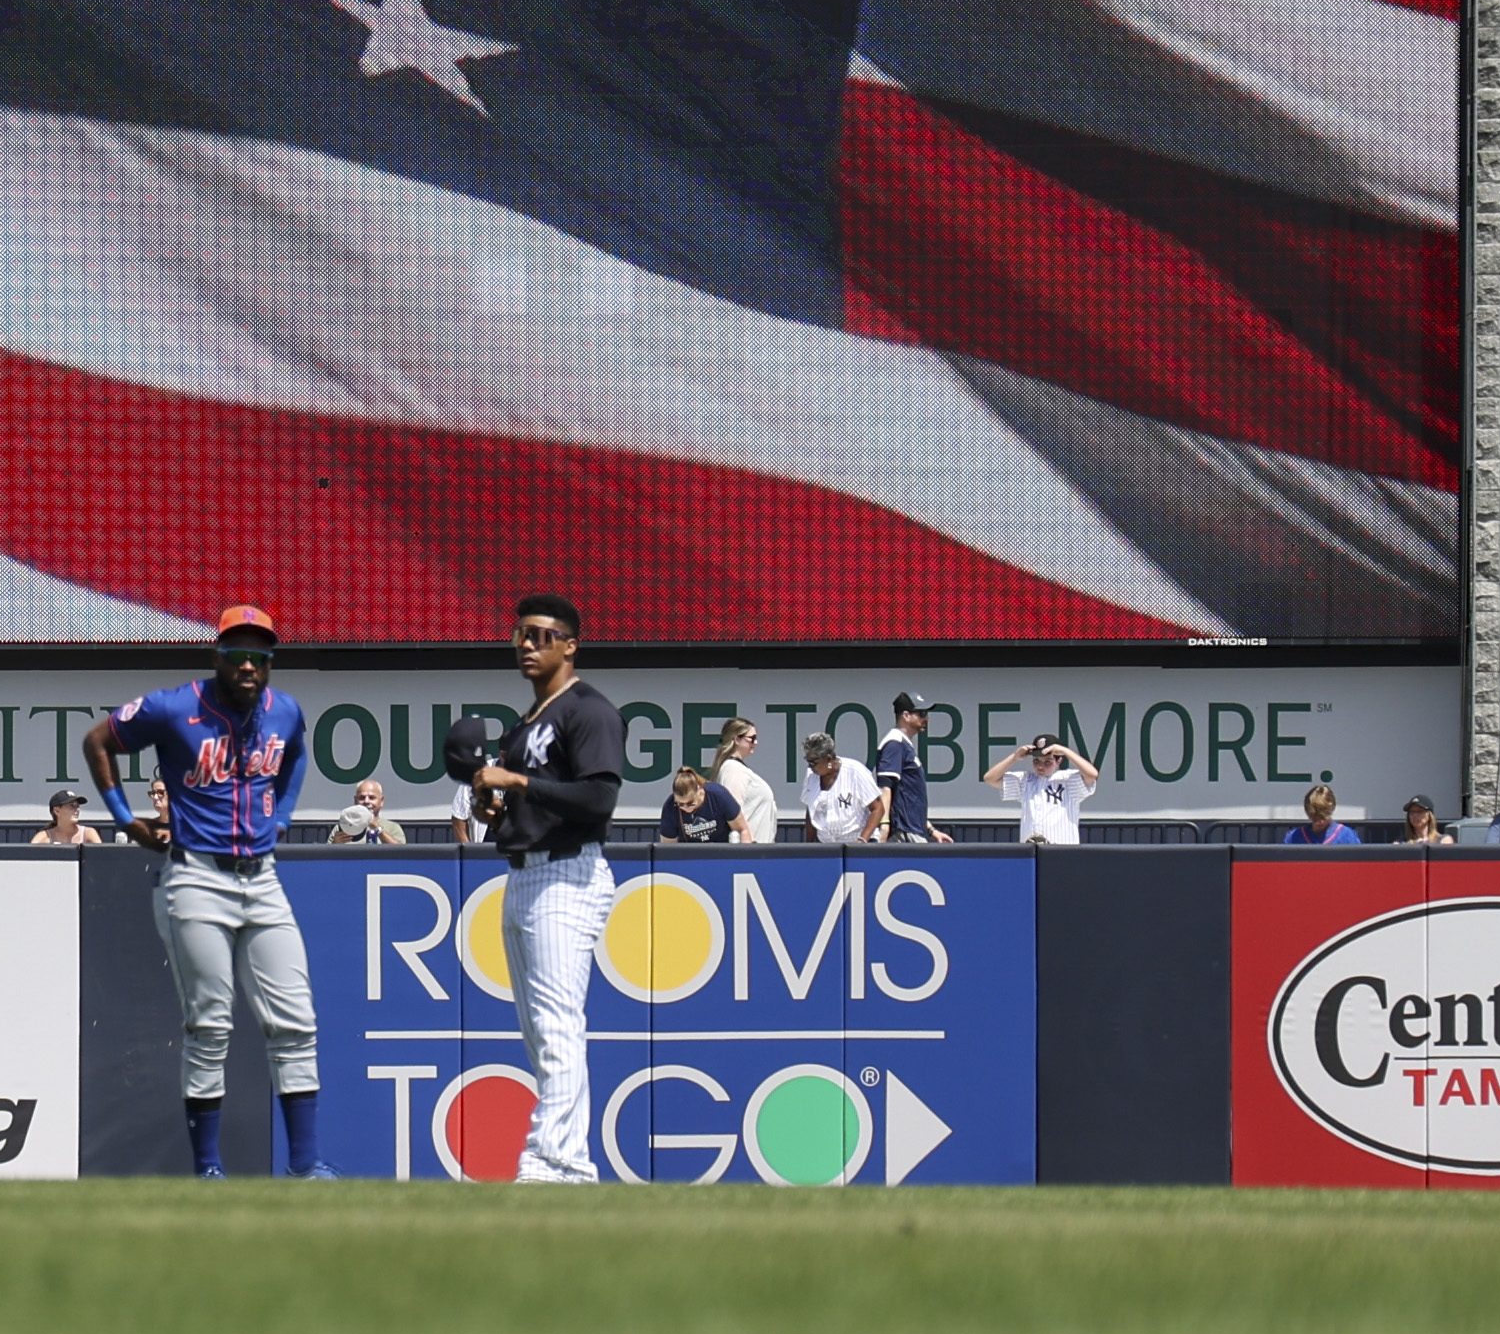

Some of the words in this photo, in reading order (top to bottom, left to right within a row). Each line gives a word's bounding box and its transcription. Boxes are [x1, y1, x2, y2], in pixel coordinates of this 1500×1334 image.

[1188, 638, 1268, 646] DAKTRONICS
[764, 701, 879, 784] TO
[1058, 701, 1333, 783] MORE.
[837, 792, 852, 810] NY
[1045, 783, 1066, 805] NY
